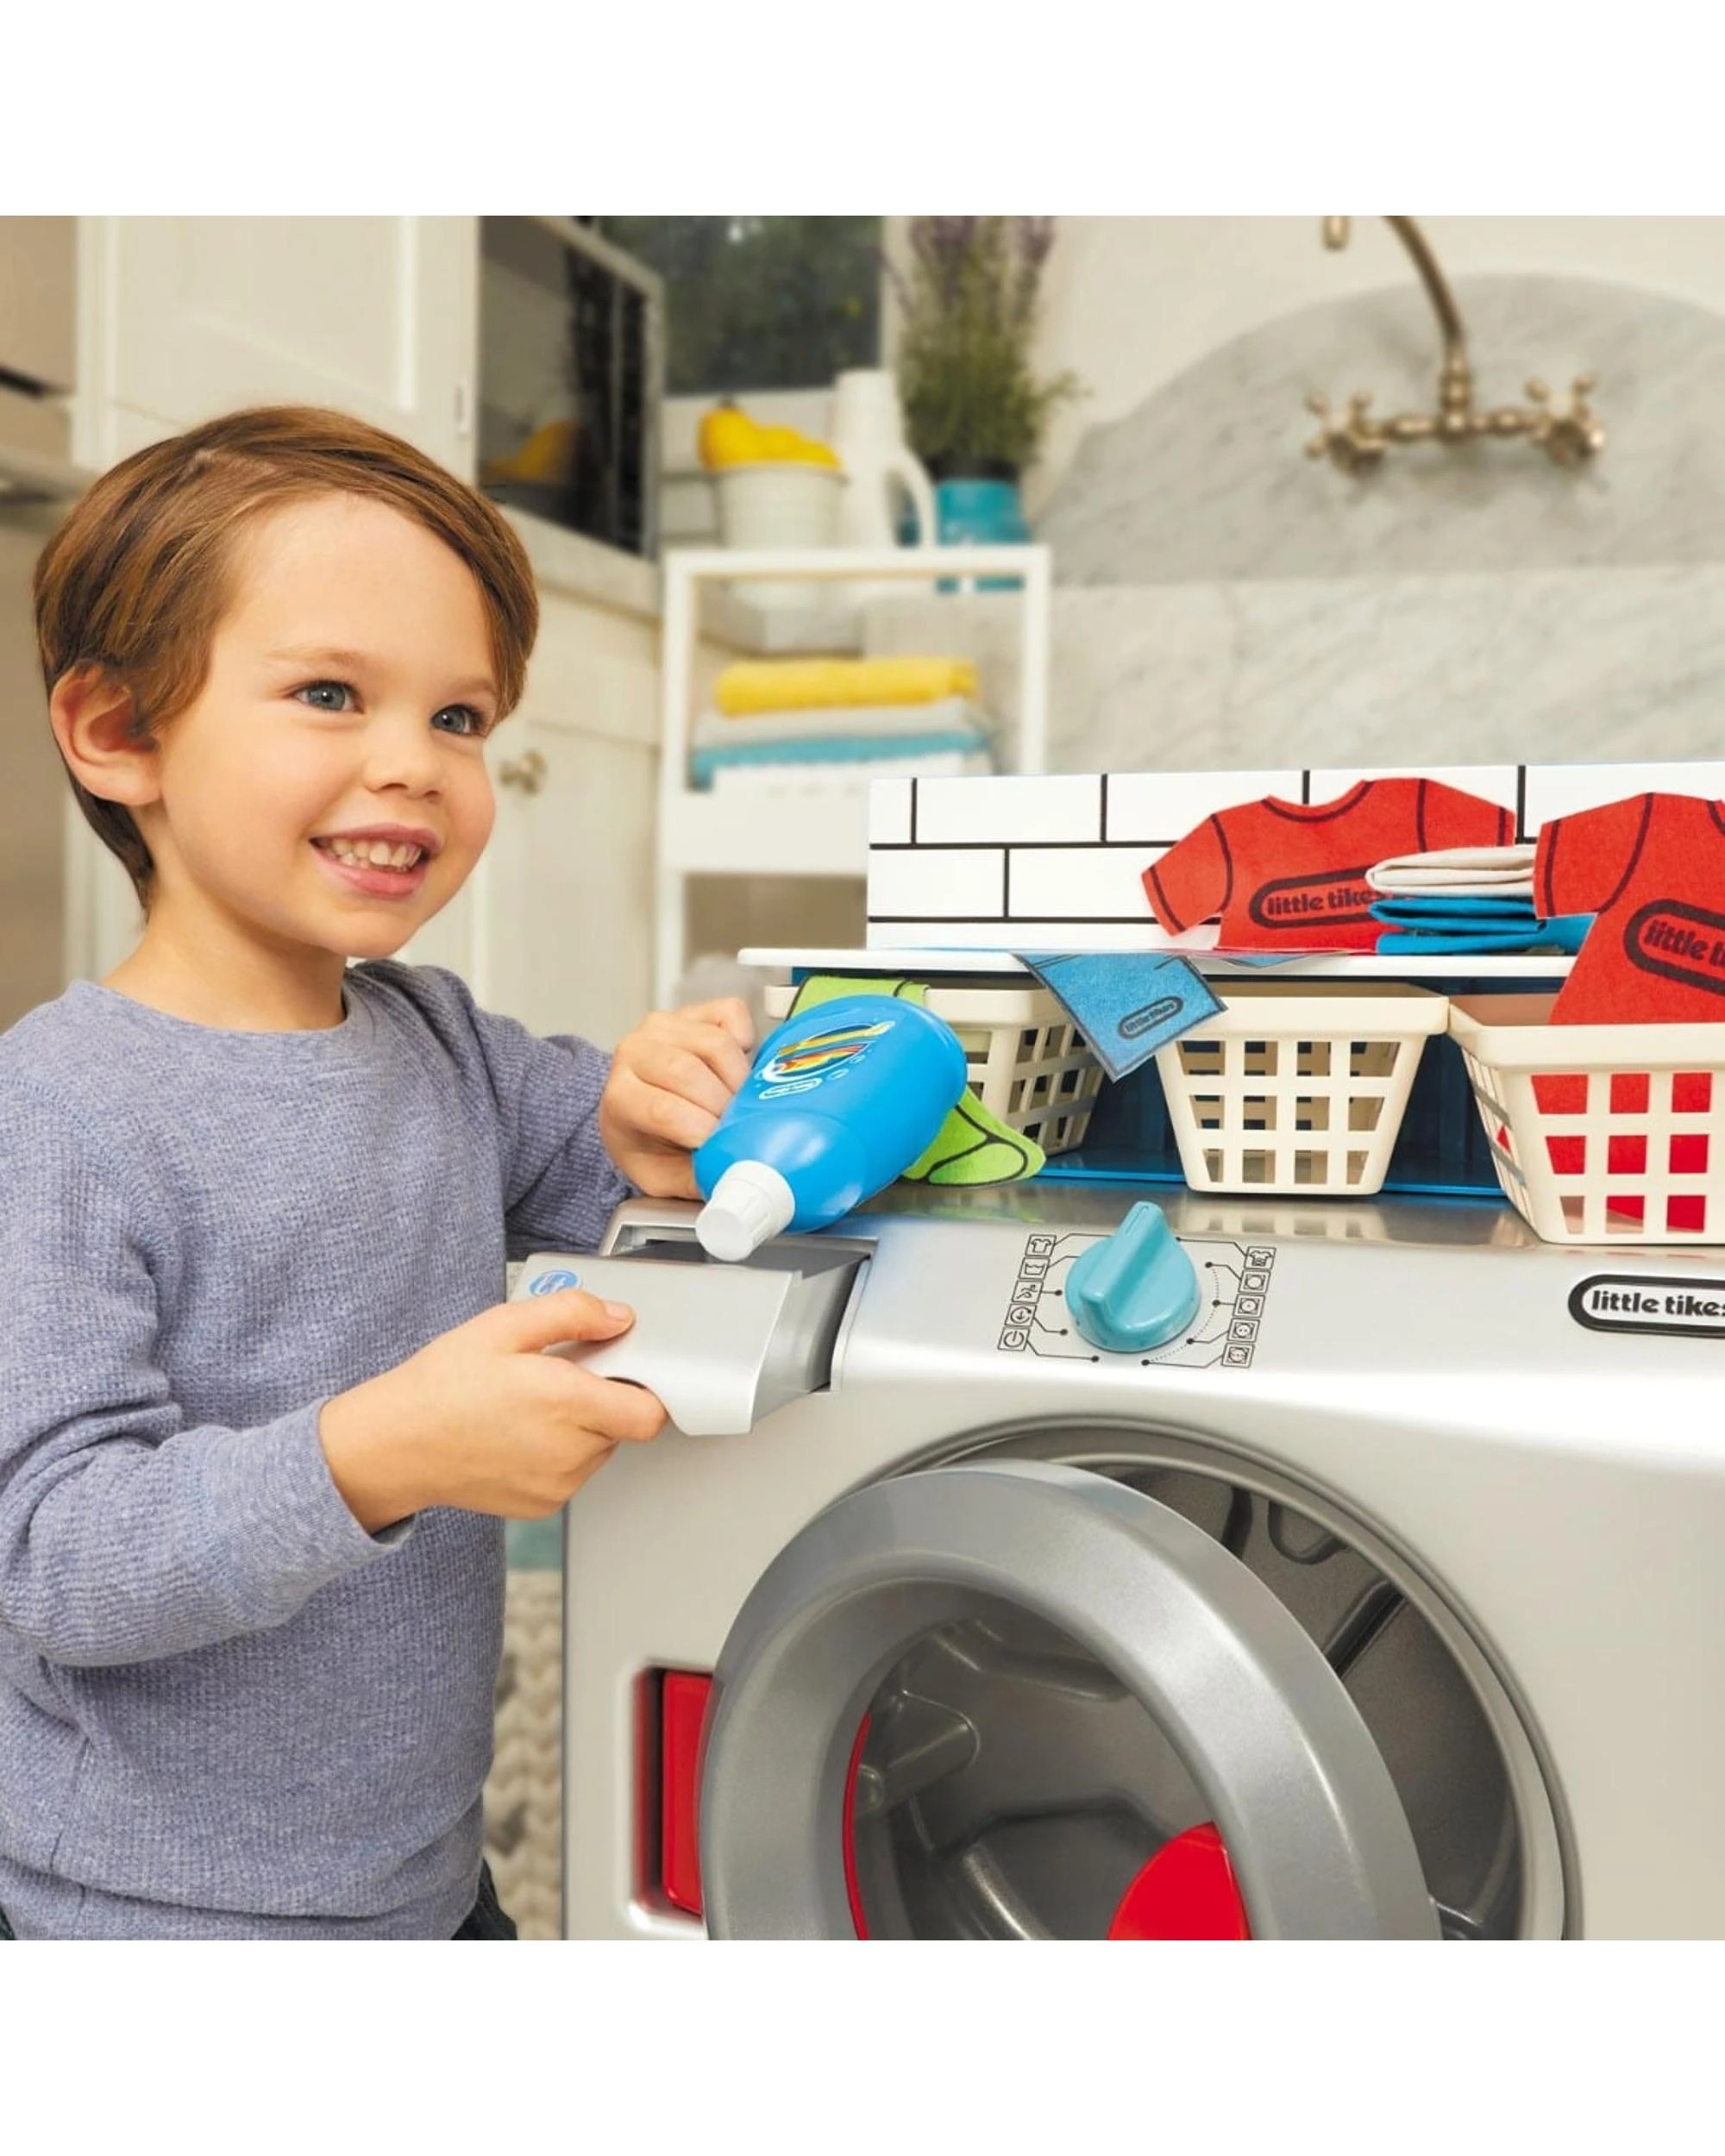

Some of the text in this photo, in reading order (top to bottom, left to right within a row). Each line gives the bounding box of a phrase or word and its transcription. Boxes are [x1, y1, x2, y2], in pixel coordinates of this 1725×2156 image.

[1267, 893, 1324, 915] little
[1644, 919, 1708, 961] little
[1591, 1290, 1659, 1313] little
